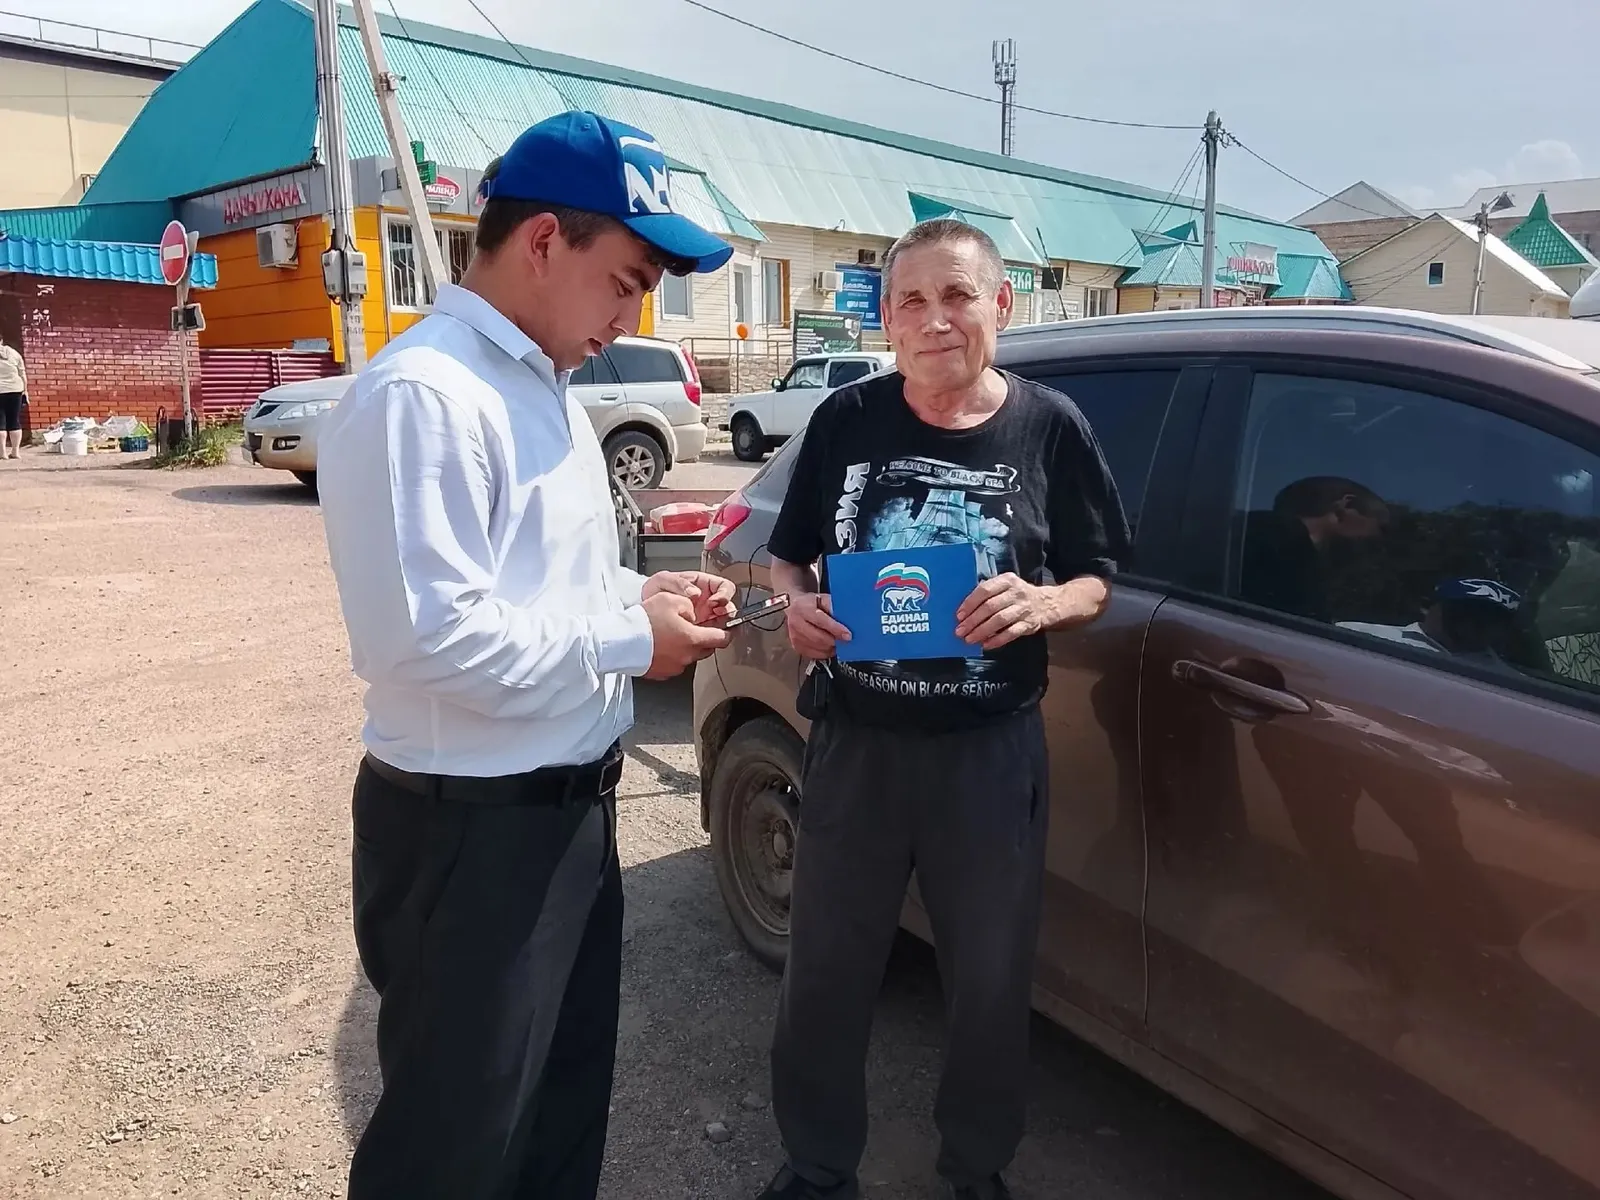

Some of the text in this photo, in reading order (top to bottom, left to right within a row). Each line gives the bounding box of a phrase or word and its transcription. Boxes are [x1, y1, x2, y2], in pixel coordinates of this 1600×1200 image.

[934, 467, 948, 477] TO
[949, 470, 985, 485] BLACK
[835, 462, 870, 554] ЗИЯ
[881, 612, 930, 634] ЕДИНАЯ РОССИЯ
[858, 670, 898, 694] SEASON
[900, 680, 917, 697] ON
[919, 680, 959, 698] BLACK
